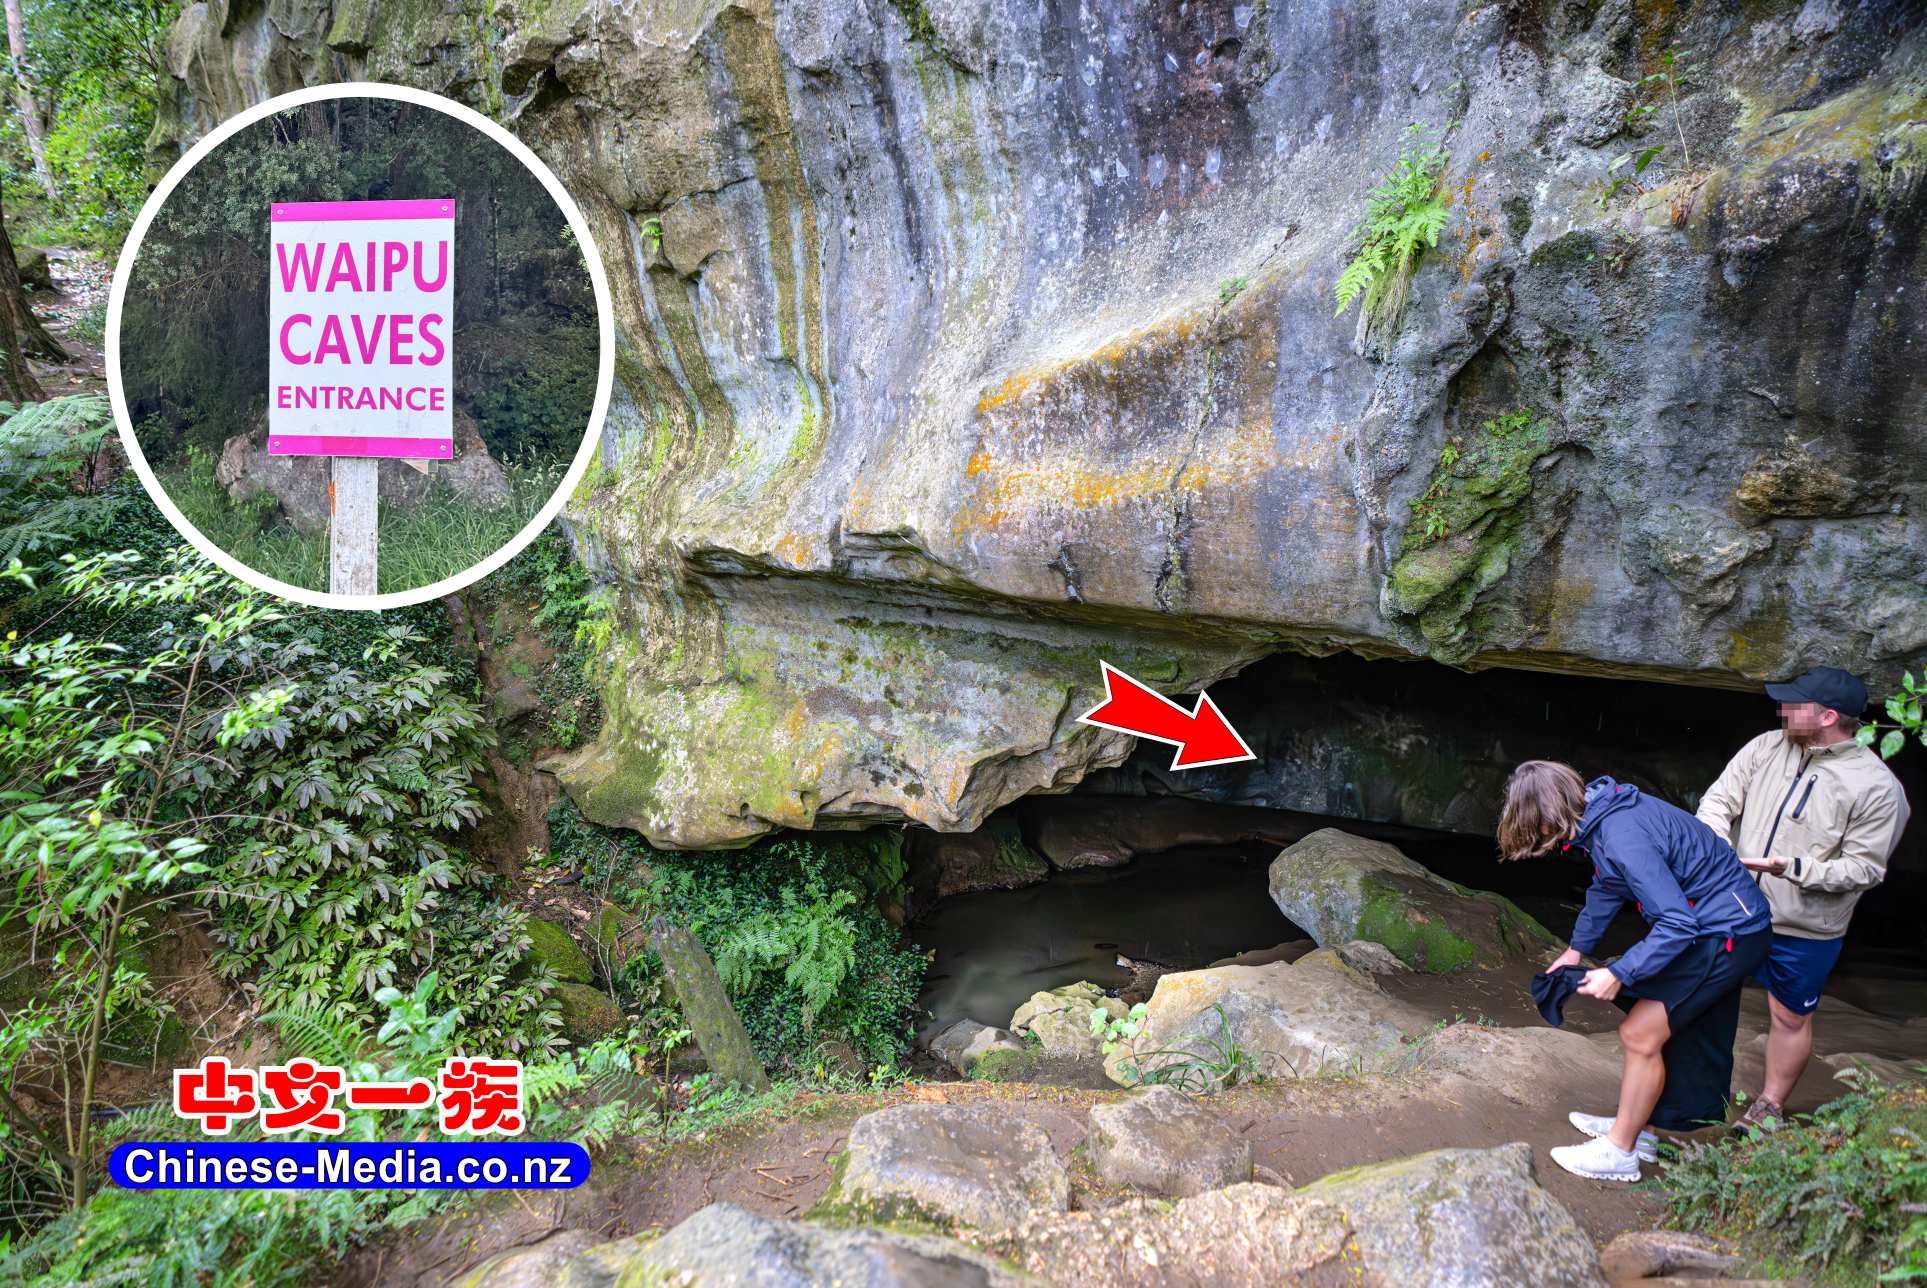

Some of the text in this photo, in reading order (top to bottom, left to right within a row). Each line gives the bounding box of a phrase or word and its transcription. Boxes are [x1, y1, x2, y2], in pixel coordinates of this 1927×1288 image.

[275, 240, 448, 293] WAIPU
[279, 313, 445, 366] CAVES
[277, 385, 445, 411] ENTRANCE
